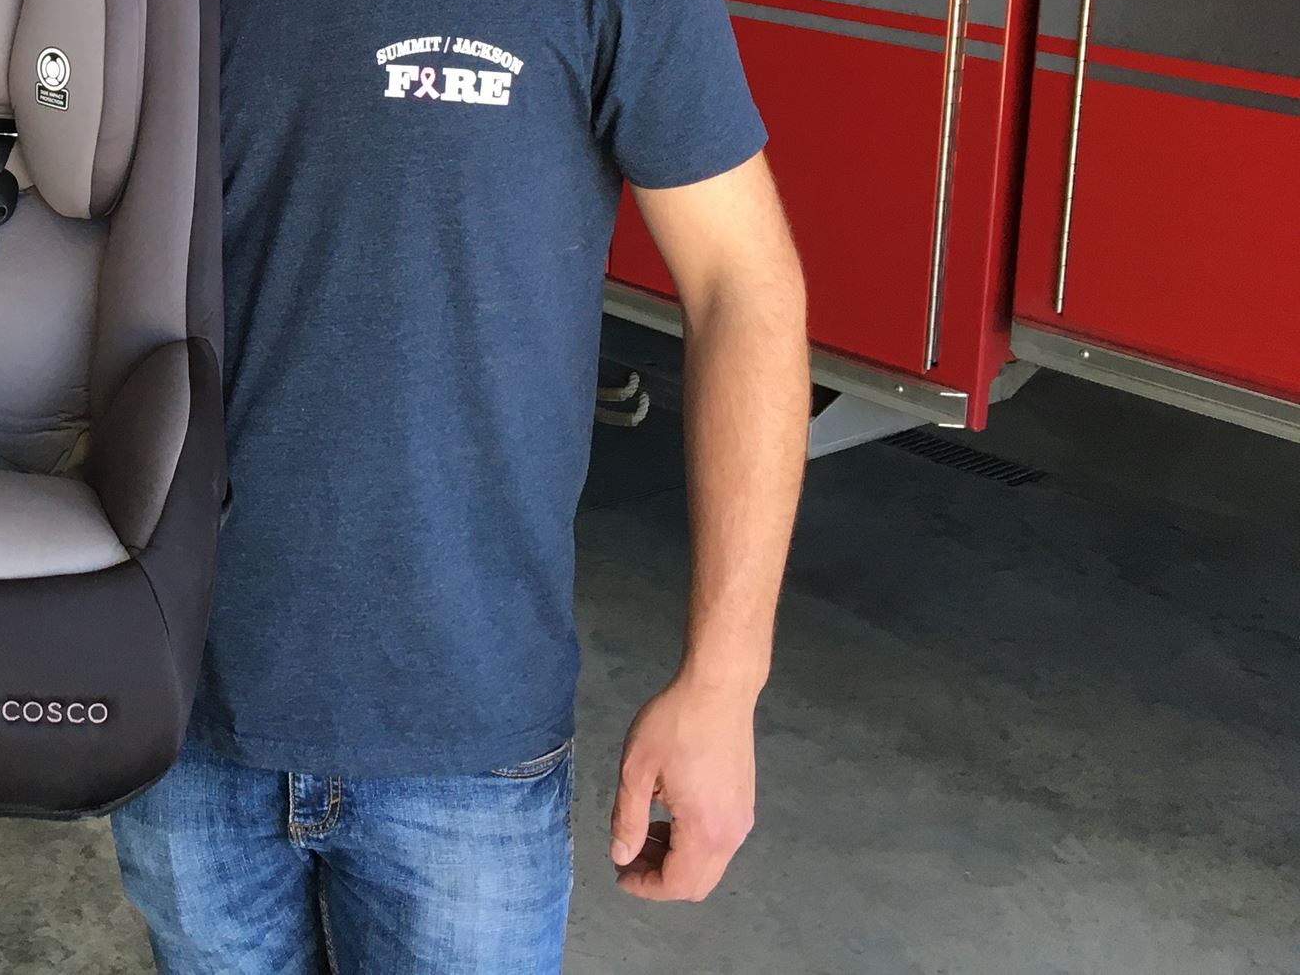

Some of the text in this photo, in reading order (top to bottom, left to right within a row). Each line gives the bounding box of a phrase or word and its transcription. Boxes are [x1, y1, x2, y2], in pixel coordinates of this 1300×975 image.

[376, 36, 442, 65] SUMMIT
[452, 37, 525, 75] JACKSON
[2, 700, 108, 723] COSCO
